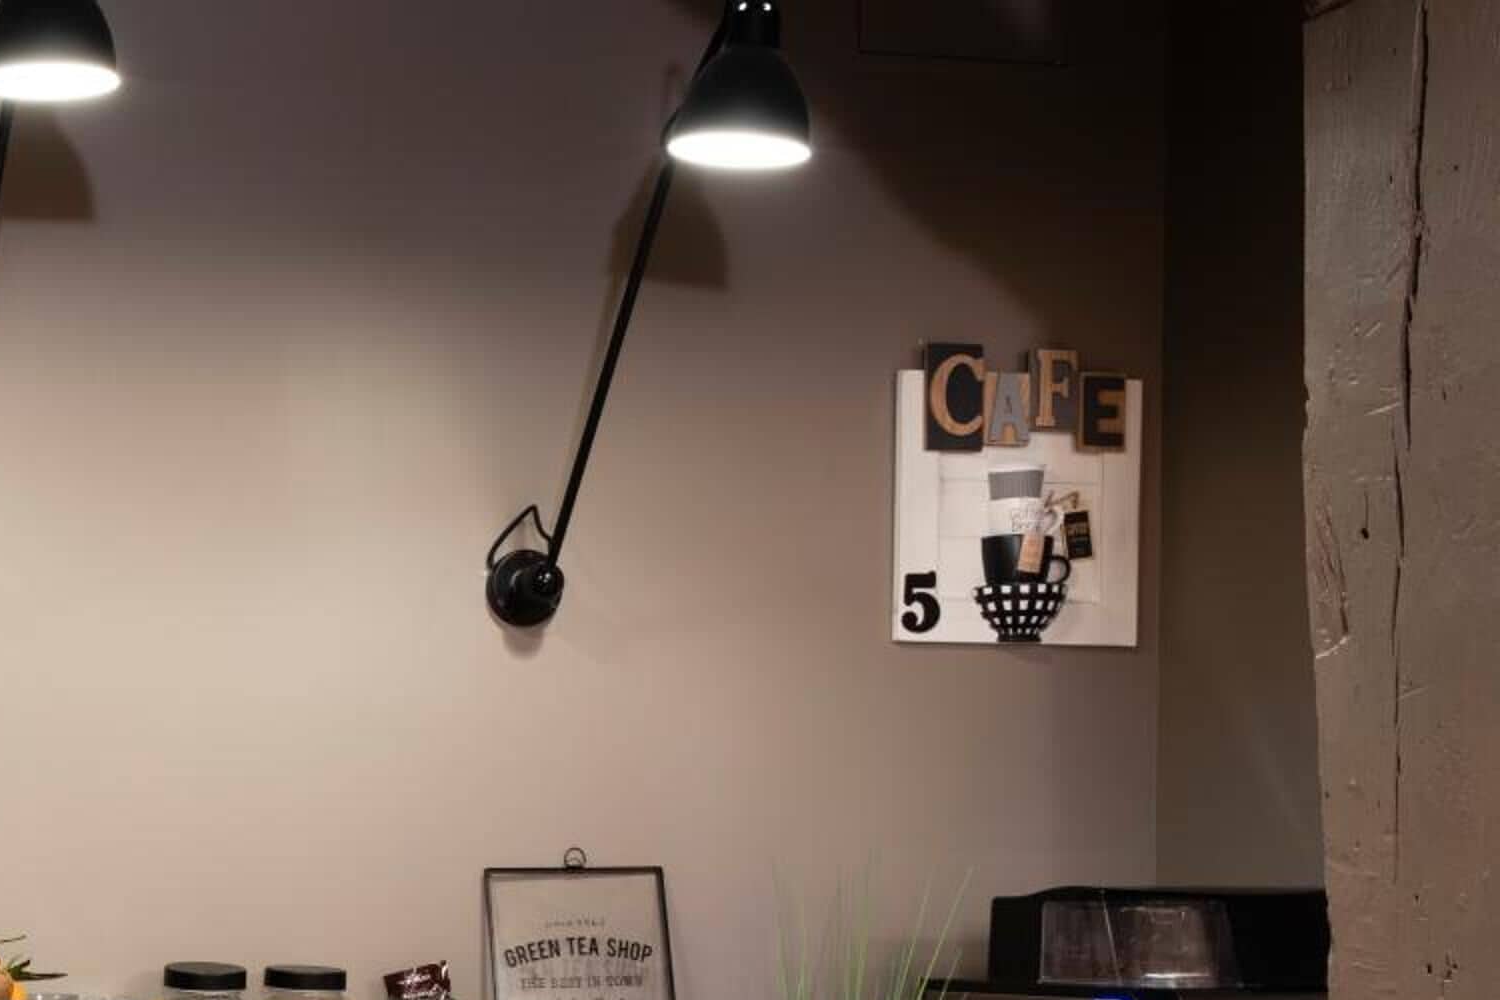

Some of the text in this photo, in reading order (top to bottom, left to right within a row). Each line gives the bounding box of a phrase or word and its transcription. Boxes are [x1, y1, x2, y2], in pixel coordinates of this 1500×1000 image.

[928, 349, 1127, 447] CAFE
[901, 570, 941, 633] 5
[503, 936, 653, 968] GREEN TEA SHOP
